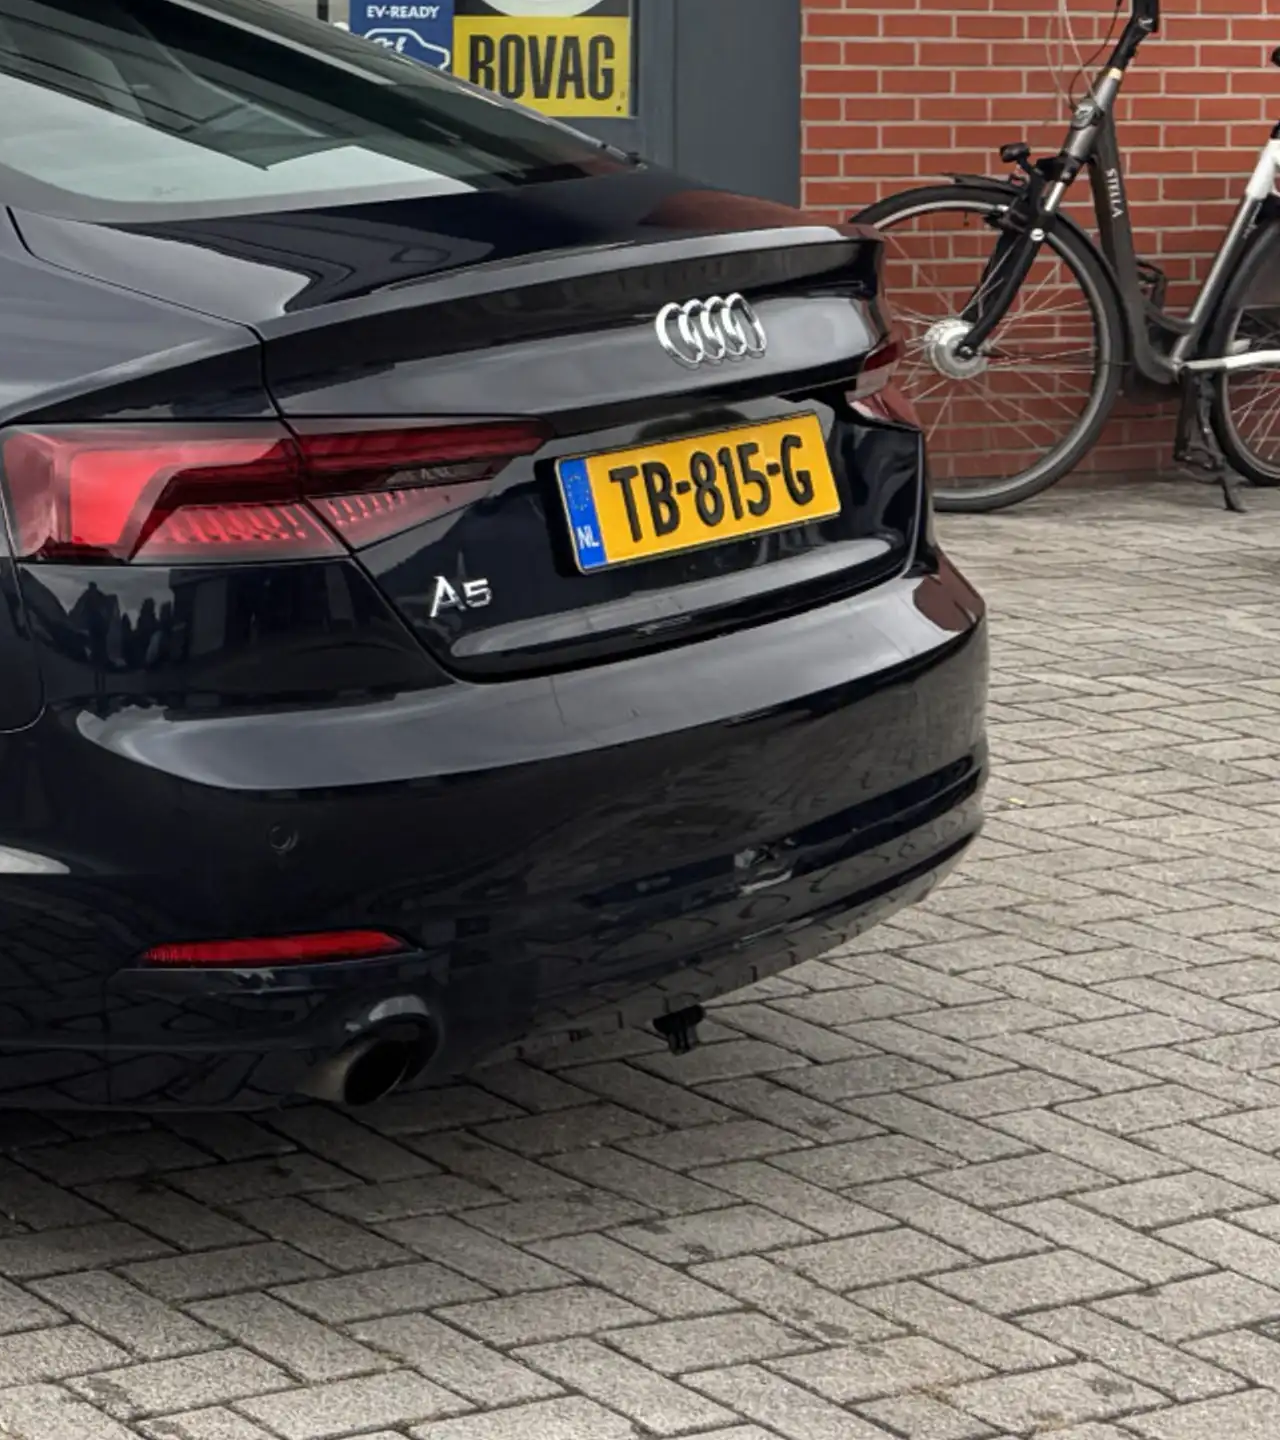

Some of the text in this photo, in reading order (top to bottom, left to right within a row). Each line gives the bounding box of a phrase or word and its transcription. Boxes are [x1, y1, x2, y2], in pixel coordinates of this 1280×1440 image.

[366, 5, 440, 19] EV-READY
[469, 34, 615, 101] BOVAG
[608, 434, 815, 543] TB-815-G
[577, 525, 600, 548] NL
[429, 576, 493, 619] A5
